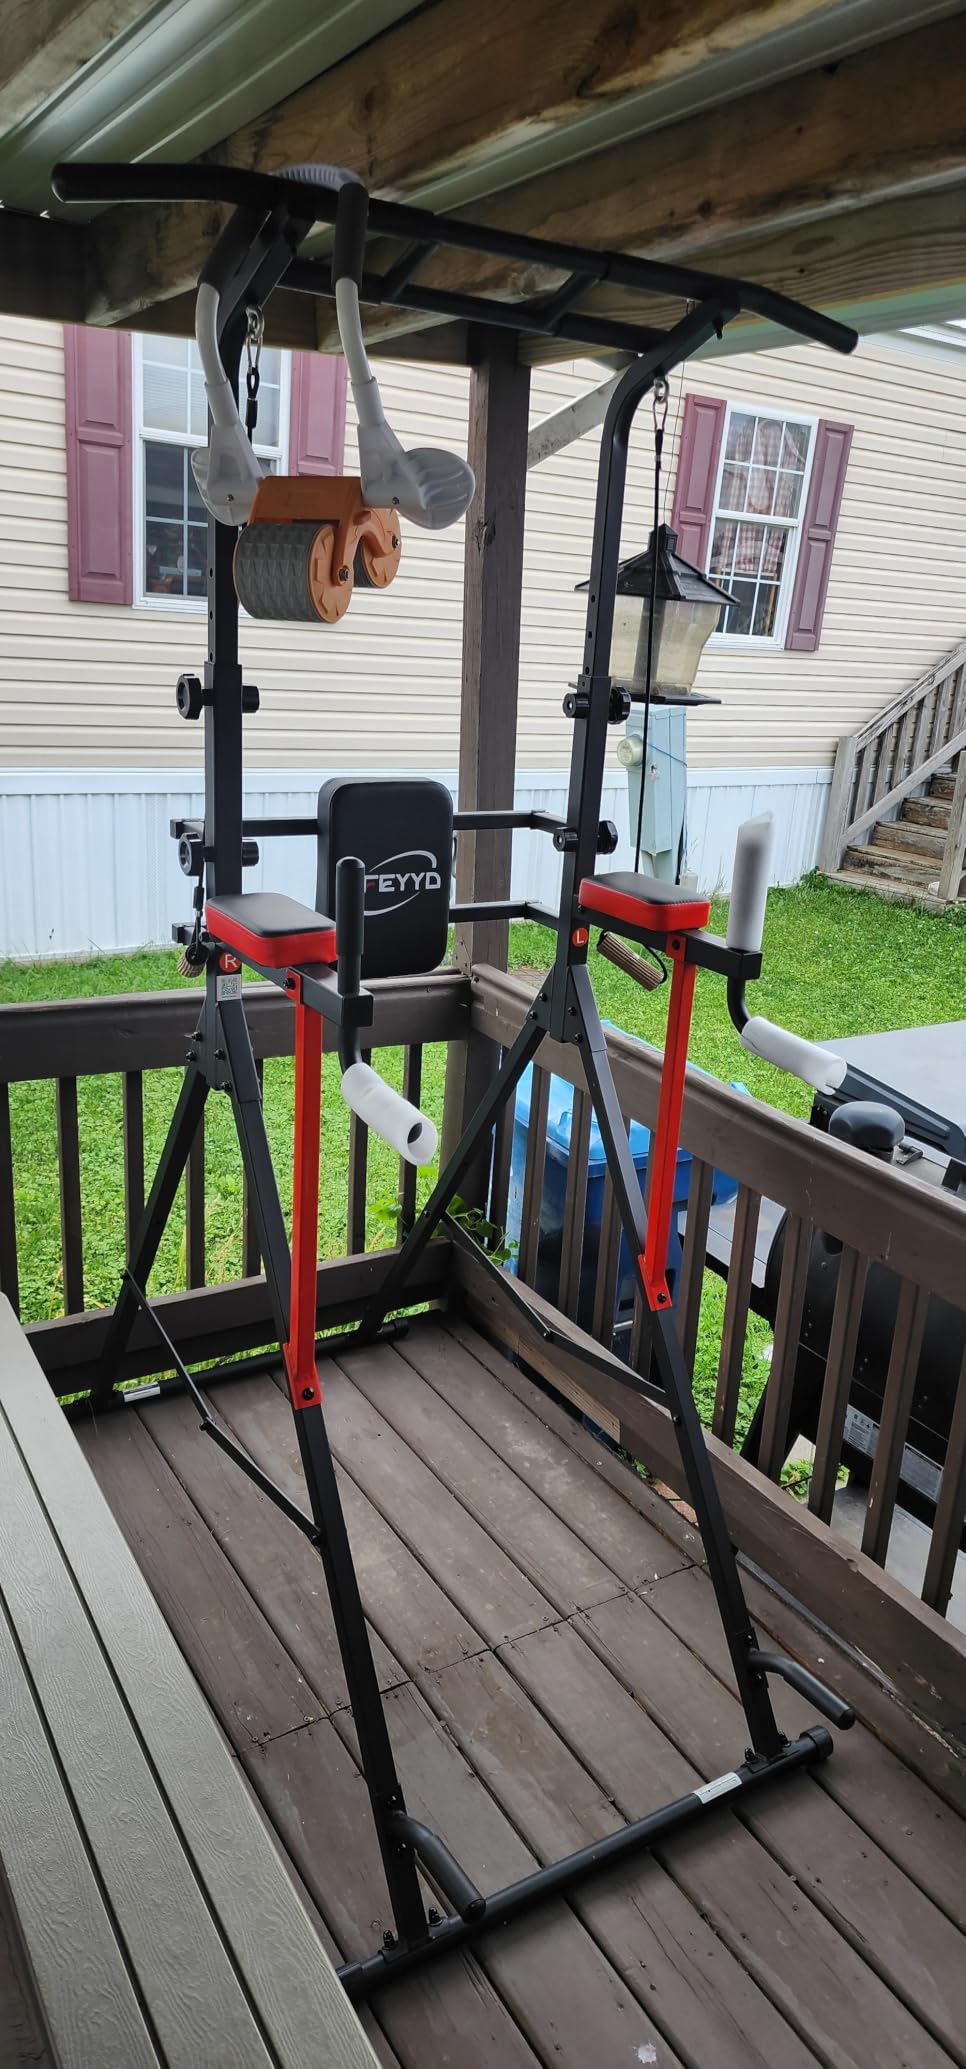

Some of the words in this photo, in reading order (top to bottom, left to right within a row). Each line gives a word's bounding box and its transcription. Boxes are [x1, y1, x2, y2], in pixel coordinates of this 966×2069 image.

[364, 872, 441, 893] FEYYD
[576, 930, 585, 944] L
[224, 953, 238, 969] R
